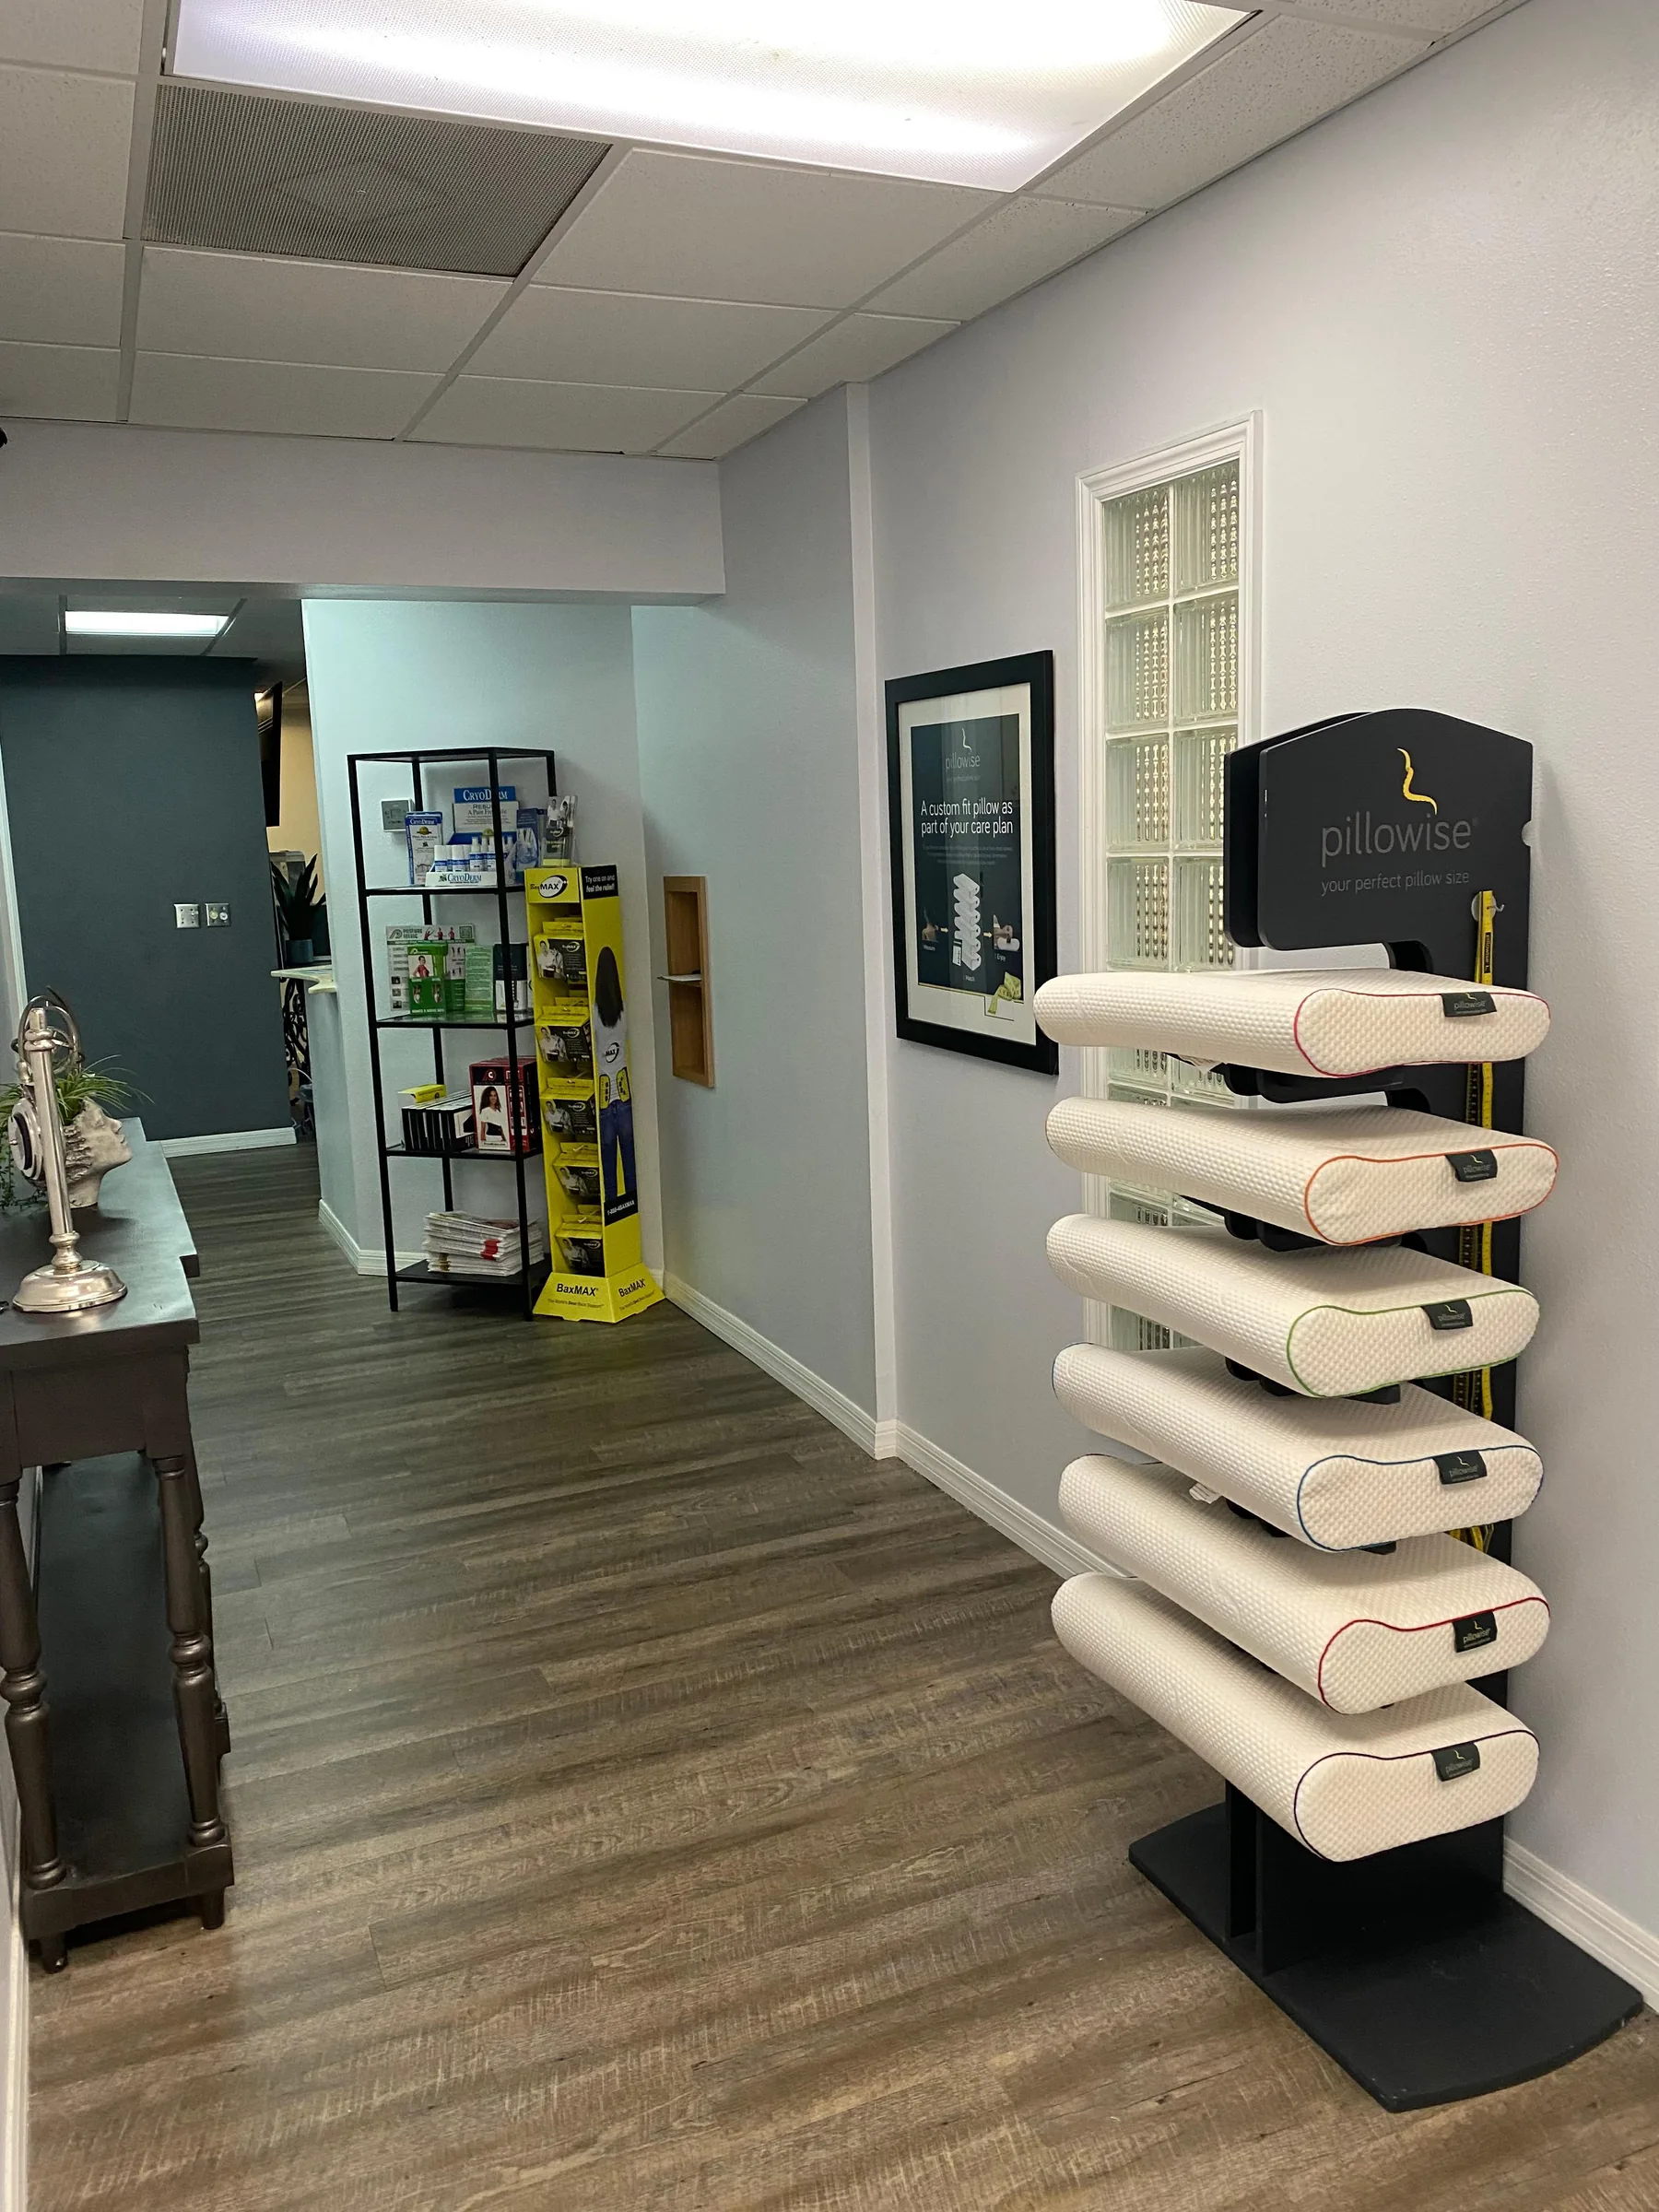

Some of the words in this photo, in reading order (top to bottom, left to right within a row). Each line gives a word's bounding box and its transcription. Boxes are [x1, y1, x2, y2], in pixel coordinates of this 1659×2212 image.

[945, 752, 981, 773] pillowise
[921, 800, 927, 816] A
[929, 801, 960, 816] custom
[962, 798, 971, 815] fit
[973, 797, 999, 818] pillow
[1002, 801, 1013, 814] as
[921, 819, 937, 838] part
[939, 817, 948, 833] of
[950, 821, 969, 838] your
[971, 821, 990, 833] care
[993, 816, 1013, 838] plan
[1322, 811, 1472, 867] pillowise
[1321, 878, 1352, 897] your
[1355, 873, 1402, 894] perfect
[1406, 870, 1441, 891] pillow
[1445, 870, 1470, 885] size
